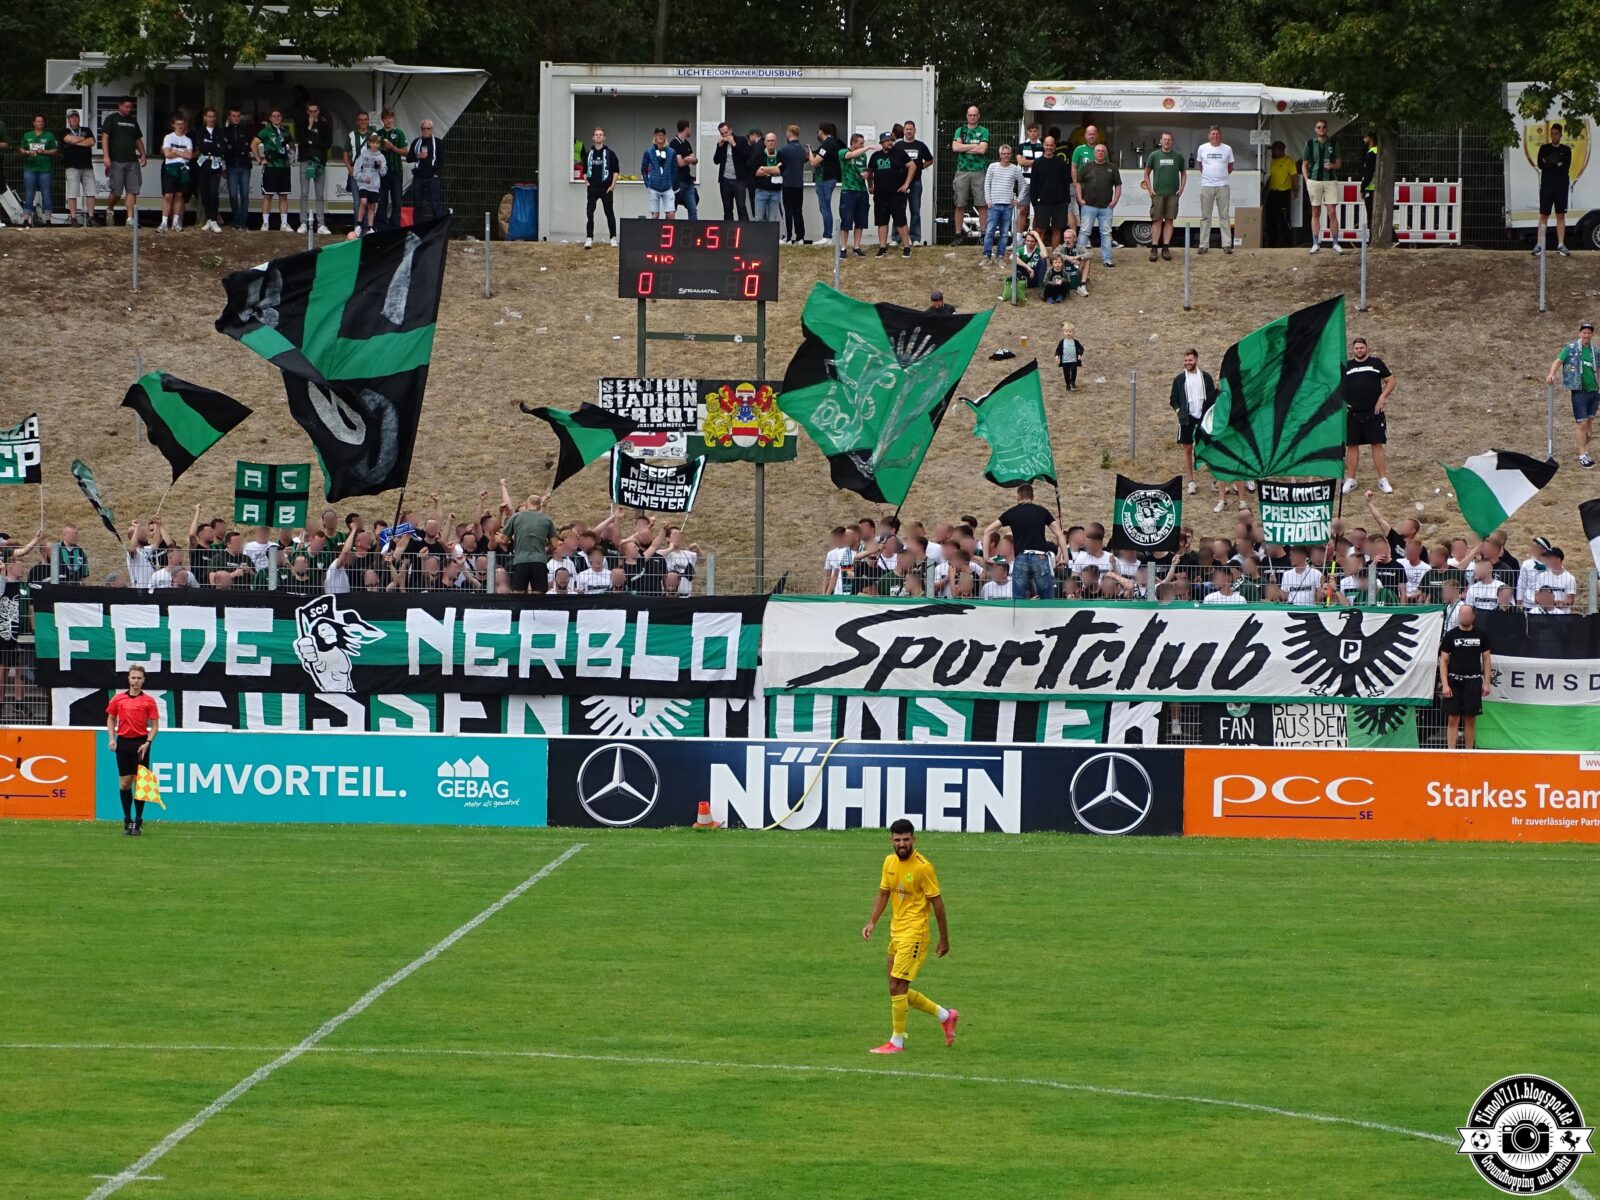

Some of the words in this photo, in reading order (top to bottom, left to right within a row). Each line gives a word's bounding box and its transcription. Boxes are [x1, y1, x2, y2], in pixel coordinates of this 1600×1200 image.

[758, 69, 803, 77] DUISBURG
[639, 272, 653, 294] 0
[678, 287, 719, 295] STRAMATEL
[744, 274, 759, 296] 0
[602, 379, 697, 393] SEKTION
[602, 392, 697, 408] STADION
[245, 470, 261, 487] A
[281, 472, 297, 489] C
[640, 463, 677, 478] FEDE
[621, 477, 692, 497] PREUSSEN
[1292, 486, 1330, 501] IMMER
[623, 491, 686, 510] MÜNSTER
[243, 504, 259, 521] A
[279, 506, 295, 524] B
[1262, 505, 1330, 522] PREUSSEN
[1263, 521, 1332, 542] STADION
[309, 602, 329, 618] SCP
[54, 602, 274, 677] FEDE
[405, 607, 743, 681] NERBLO
[784, 603, 1272, 691] Sportclub
[1219, 717, 1255, 740] FAN
[1275, 717, 1309, 738] AUS
[1315, 717, 1347, 738] DEM
[152, 762, 407, 798] EIMVORTEIL.
[437, 779, 509, 798] GEBAG
[710, 745, 1023, 834] NÜHLEN
[52, 788, 67, 798] SE
[1426, 781, 1527, 809] Starkes
[1359, 810, 1374, 820] SE
[1512, 817, 1523, 825] Ihr
[1525, 817, 1579, 828] zuverlässiger
